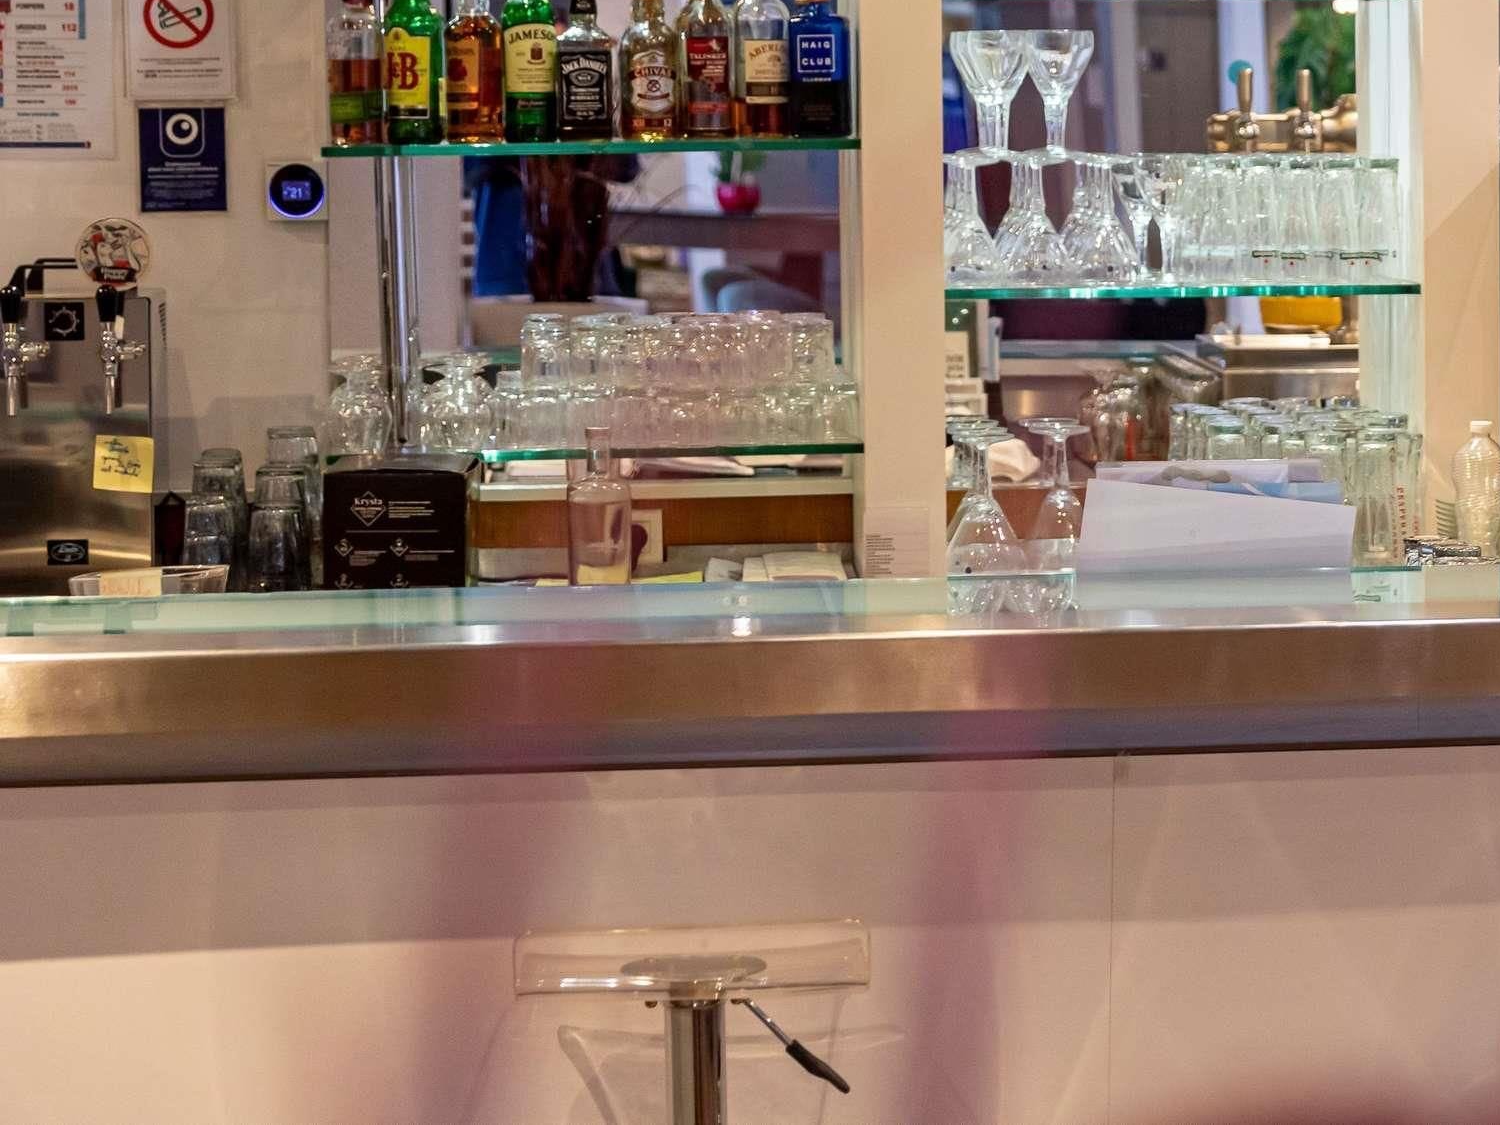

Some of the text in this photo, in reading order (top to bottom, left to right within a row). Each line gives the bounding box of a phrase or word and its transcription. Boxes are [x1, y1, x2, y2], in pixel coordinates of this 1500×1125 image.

[509, 28, 554, 44] JAMESO
[749, 43, 786, 59] ABERL
[801, 41, 831, 50] HAIG
[801, 58, 832, 66] CLUB
